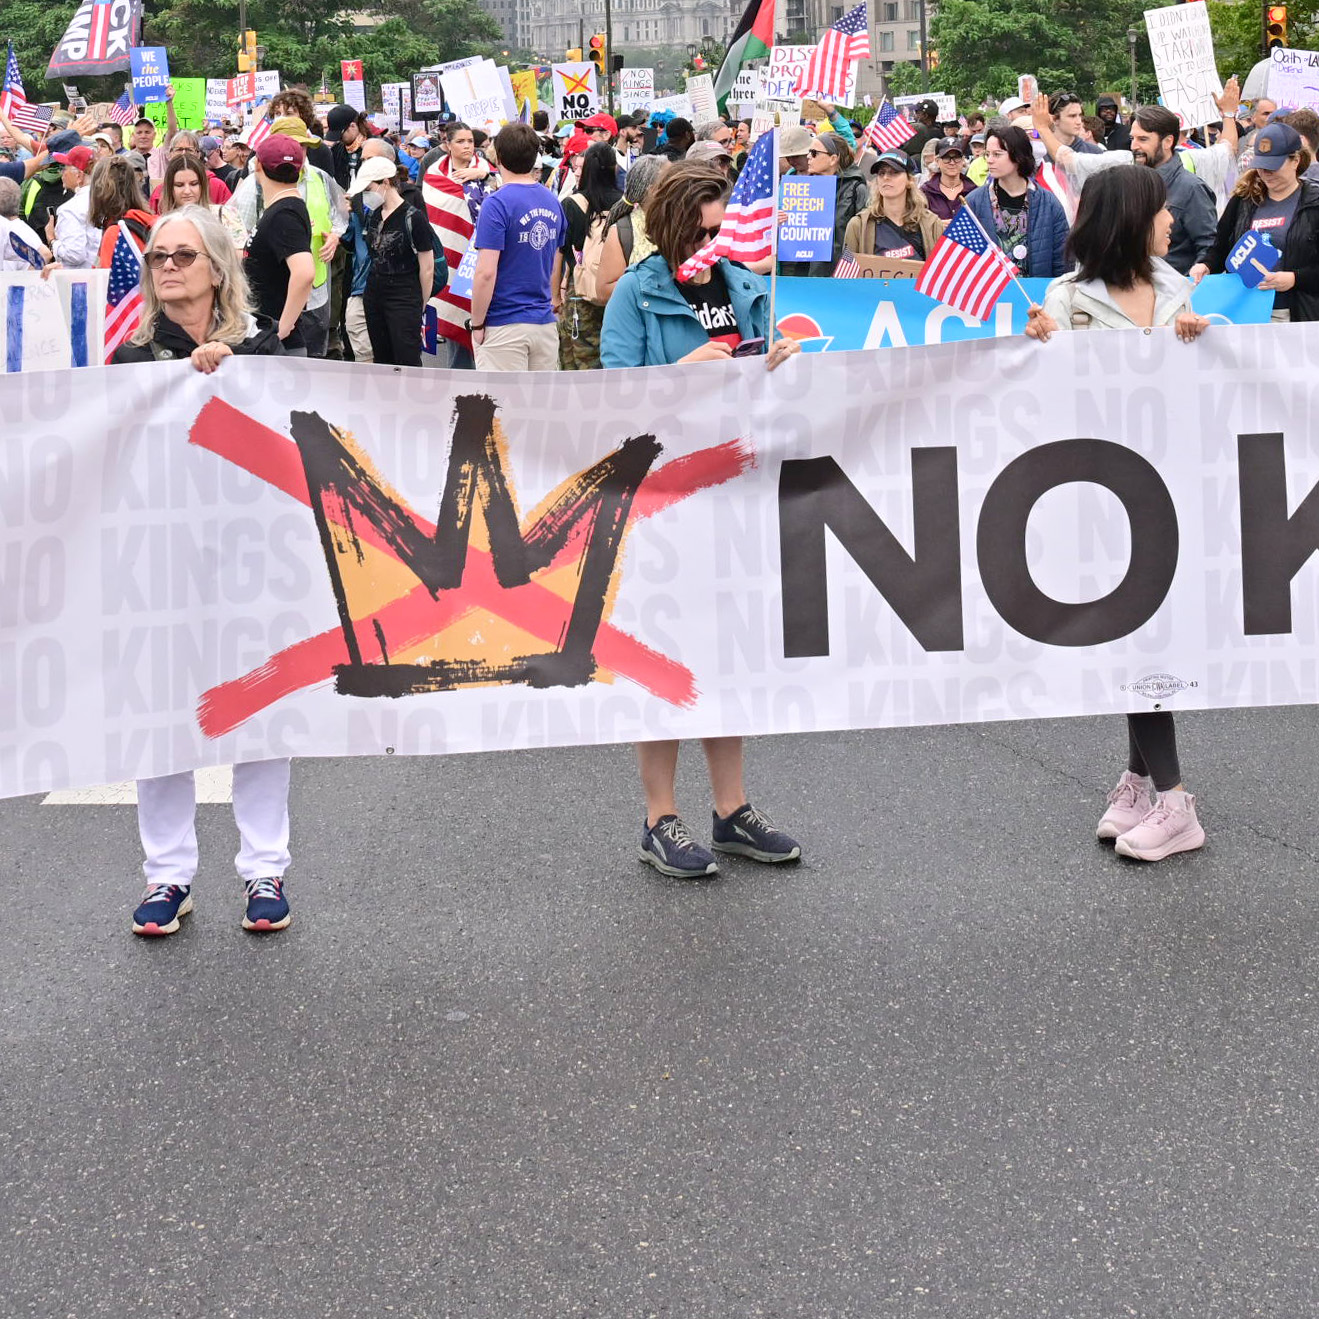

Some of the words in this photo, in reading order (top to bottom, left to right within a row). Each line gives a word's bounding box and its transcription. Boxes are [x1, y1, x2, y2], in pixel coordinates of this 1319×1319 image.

[141, 51, 156, 62] WE
[774, 47, 816, 64] DISS
[1273, 49, 1302, 64] Oath
[141, 63, 159, 74] the
[631, 69, 646, 78] NO
[133, 75, 170, 88] PEOPLE
[233, 75, 249, 88] STOP
[623, 79, 652, 88] KINGS
[233, 85, 249, 97] ICE
[623, 90, 650, 99] SINCE
[730, 88, 756, 100] hrer
[464, 96, 500, 118] NOPE
[562, 93, 590, 110] NO
[560, 106, 596, 121] KINGS
[153, 117, 191, 128] BRT
[783, 183, 810, 196] FREE
[782, 198, 824, 211] SPEECH
[1252, 218, 1283, 230] RESIST
[780, 227, 831, 241] COUNTRY
[885, 246, 912, 258] RESIST
[1230, 235, 1257, 269] ACLU
[863, 300, 1012, 350] ACL
[777, 437, 1180, 660] NO
[100, 516, 313, 617] KINGS
